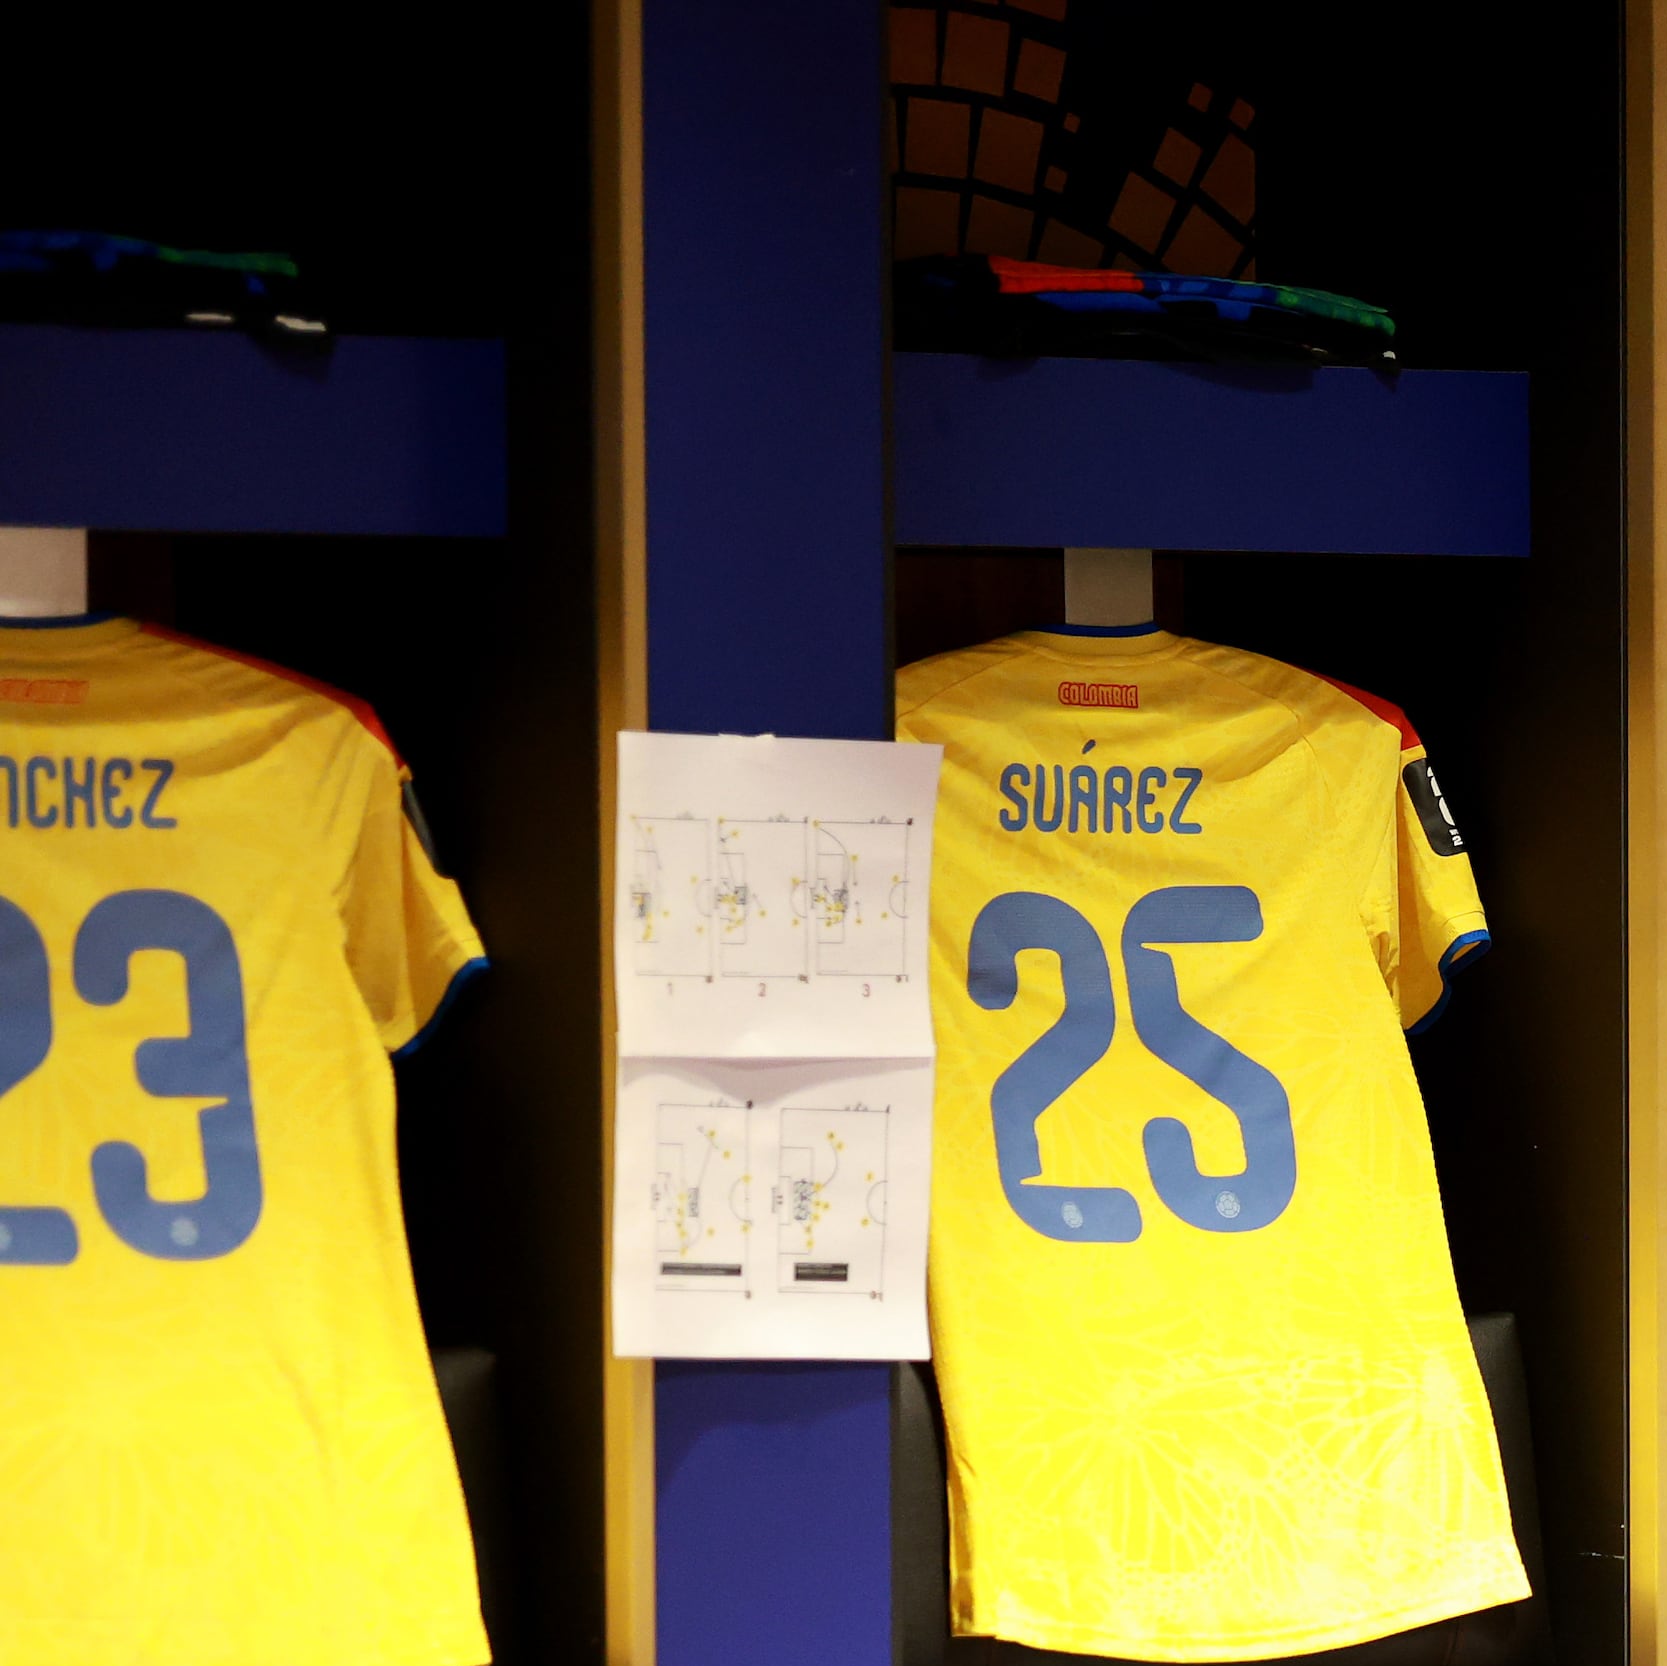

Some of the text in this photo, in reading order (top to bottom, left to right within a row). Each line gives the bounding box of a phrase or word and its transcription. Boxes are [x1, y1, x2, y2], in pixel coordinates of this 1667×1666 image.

[1058, 681, 1139, 709] COLOMBIA
[999, 739, 1203, 834] SUÁREZ
[758, 982, 766, 997] 2
[862, 983, 871, 998] 3
[968, 886, 1297, 1243] 25
